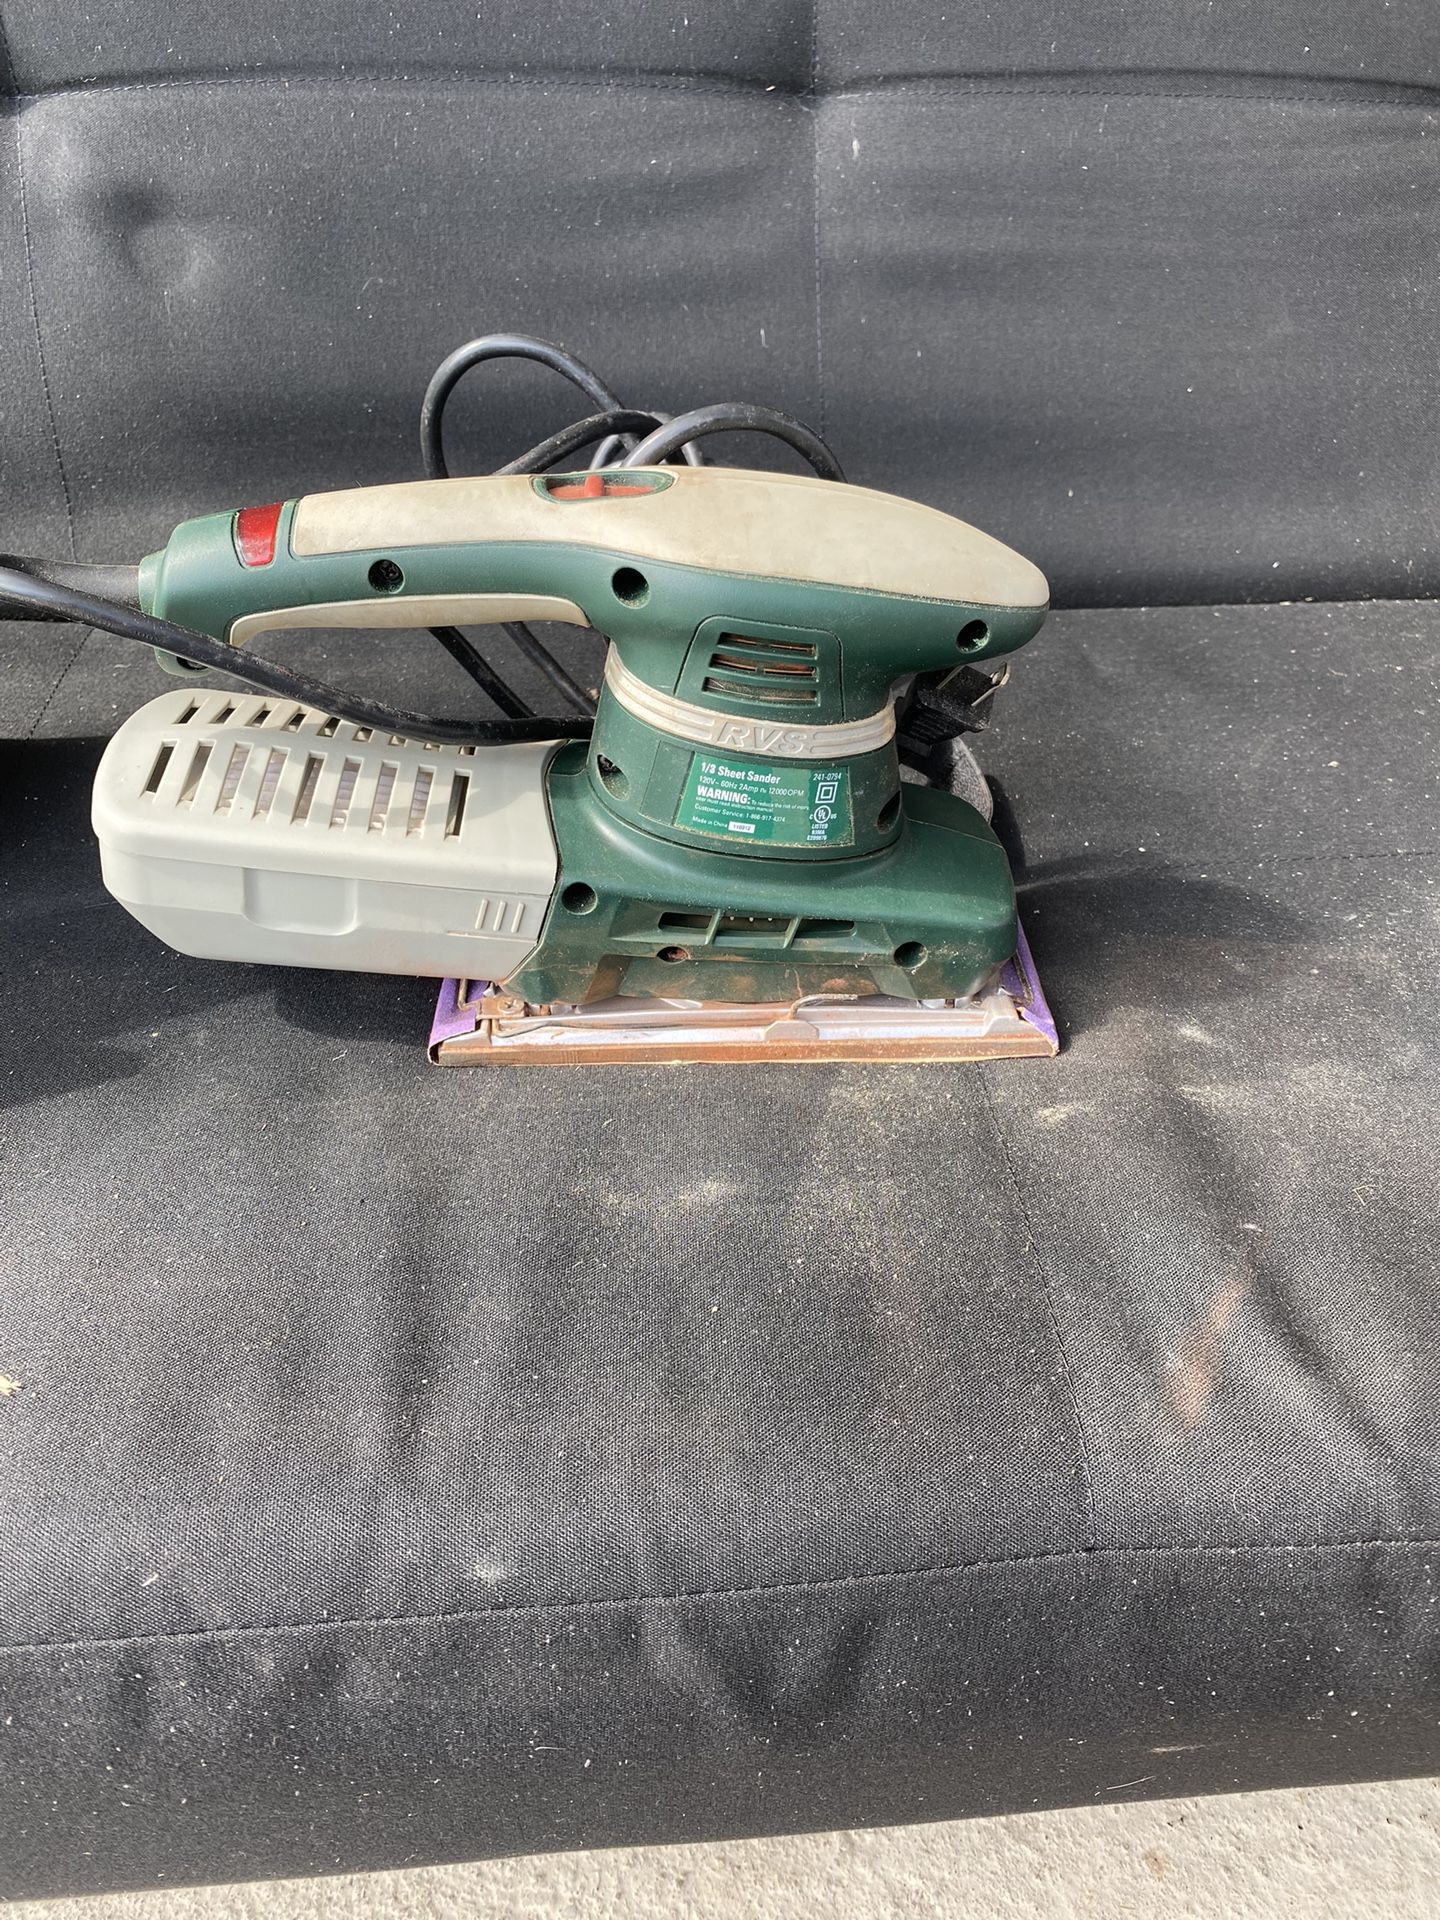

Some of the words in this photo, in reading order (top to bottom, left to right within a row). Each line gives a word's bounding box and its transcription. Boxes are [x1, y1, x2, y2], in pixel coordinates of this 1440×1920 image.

[717, 721, 808, 754] RVS
[701, 762, 716, 774] 1/3
[717, 765, 746, 780] Sheet
[746, 770, 781, 784] Sander
[720, 780, 737, 789] 60Hz
[738, 783, 759, 793] 2Amp
[697, 785, 751, 805] WARNING:
[694, 803, 721, 814] Customer
[692, 815, 707, 824] Made
[713, 820, 728, 828] China
